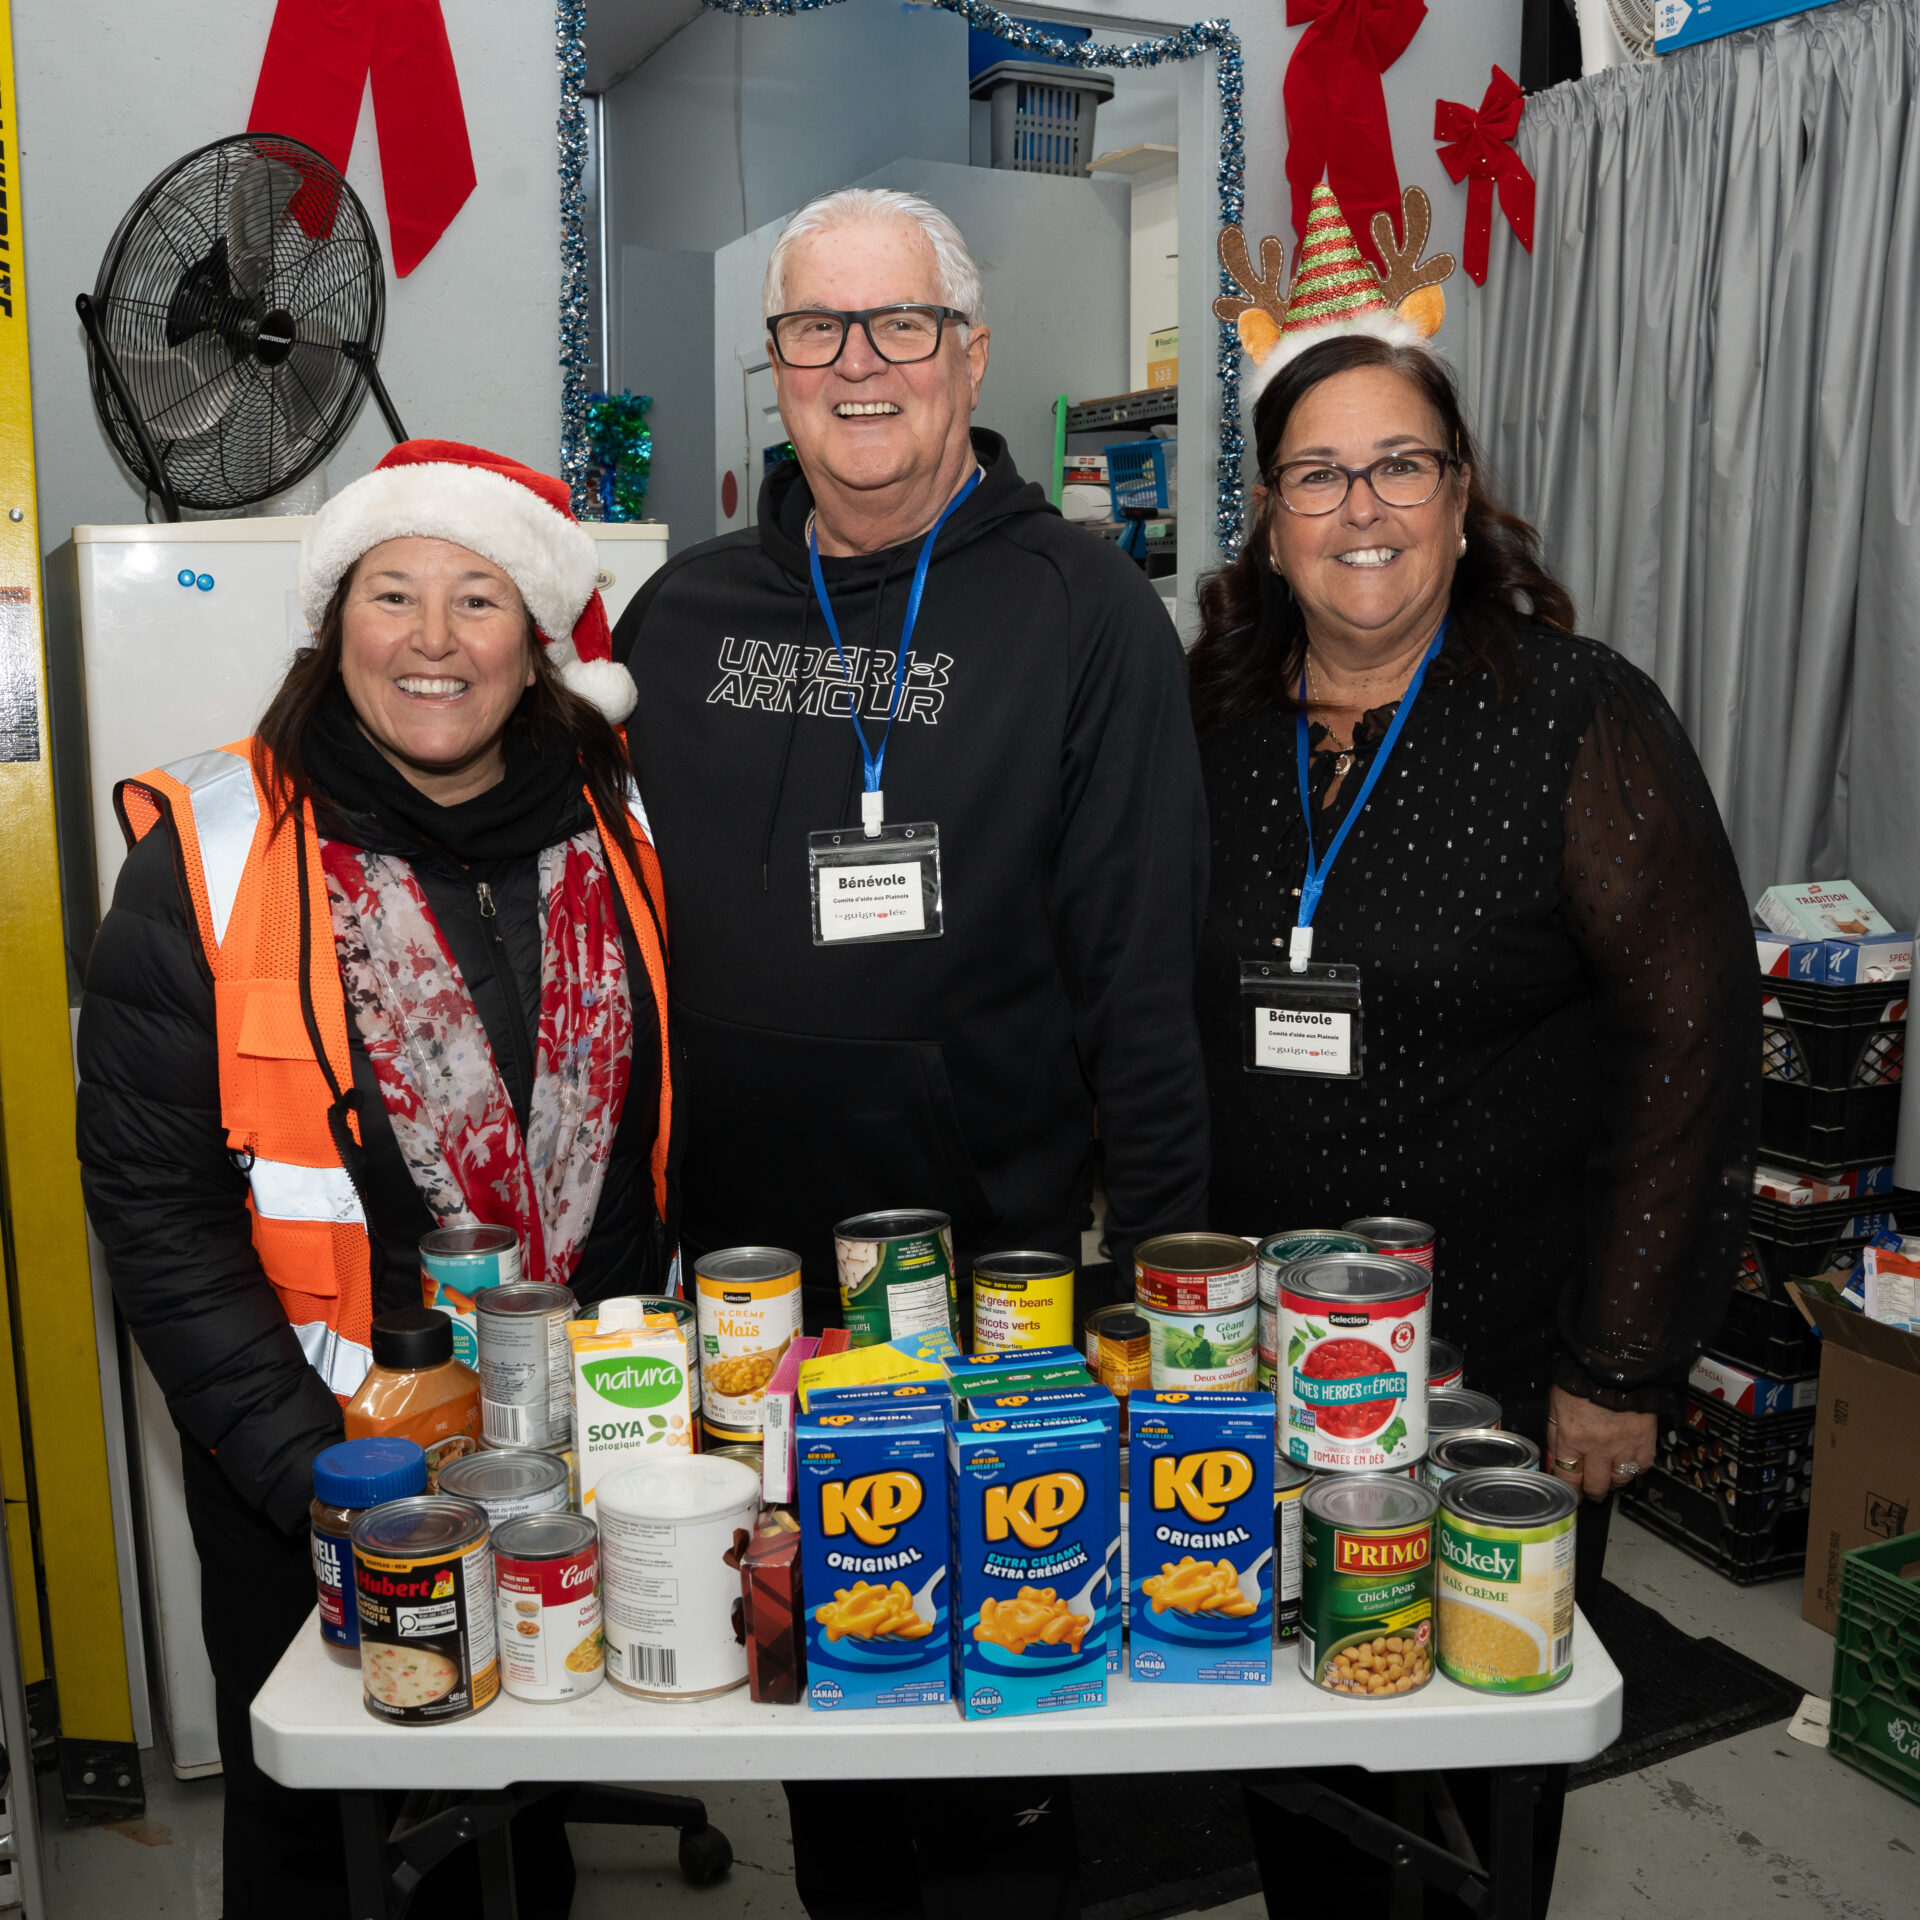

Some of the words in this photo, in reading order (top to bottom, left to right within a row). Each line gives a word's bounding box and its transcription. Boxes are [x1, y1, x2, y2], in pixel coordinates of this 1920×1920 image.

[718, 637, 897, 685] UNDER
[706, 672, 945, 725] ARMOUR
[838, 873, 906, 889] Bénévole
[1795, 893, 1849, 905] TRADITION
[1269, 1010, 1332, 1025] Bénévole
[723, 1294, 751, 1302] Selection
[987, 1296, 1017, 1307] green
[1019, 1297, 1054, 1308] beans
[713, 1310, 725, 1318] EN
[1330, 1314, 1368, 1324] Selection
[718, 1318, 760, 1338] Maïs
[1011, 1320, 1041, 1330] verts
[1216, 1320, 1244, 1333] Géant
[1222, 1330, 1241, 1341] Vert
[1004, 1350, 1053, 1359] ORIGINAL
[595, 1365, 676, 1392] natura
[1193, 1374, 1216, 1382] Deux
[1218, 1367, 1248, 1380] couleurs
[963, 1380, 982, 1390] Pasta
[982, 1378, 999, 1387] Salad
[1294, 1374, 1319, 1399] FINES
[1322, 1382, 1362, 1400] HERBES
[1363, 1384, 1371, 1395] ET
[1373, 1376, 1406, 1395] ÉPICES
[1034, 1392, 1087, 1402] ORIGINAL
[858, 1414, 913, 1422] ORIGINAL
[587, 1420, 644, 1443] SOYA
[588, 1440, 641, 1453] biologique
[1313, 1450, 1350, 1465] TOMATES
[1353, 1456, 1366, 1465] EN
[1369, 1453, 1385, 1464] DÉS
[1155, 1526, 1251, 1549] ORIGINAL
[987, 1552, 1028, 1569] EXTRA
[1031, 1543, 1082, 1568] CREAMY
[1342, 1537, 1428, 1567] PRIMO
[1441, 1529, 1516, 1580] Stokely
[827, 1548, 923, 1573] ORIGINAL
[983, 1563, 1025, 1580] EXTRA
[1027, 1552, 1088, 1579] CRÉMEUX
[1357, 1590, 1389, 1603] Chick
[1391, 1582, 1416, 1597] Peas
[1464, 1585, 1509, 1602] CRÈME
[1134, 1659, 1166, 1670] CANADA
[1243, 1671, 1259, 1681] 200
[1477, 1671, 1507, 1684] CHOIX
[812, 1689, 843, 1699] CANADA
[922, 1692, 938, 1701] 200
[940, 1693, 945, 1702] g
[1082, 1694, 1096, 1702] 175
[970, 1696, 1002, 1706] CANADA
